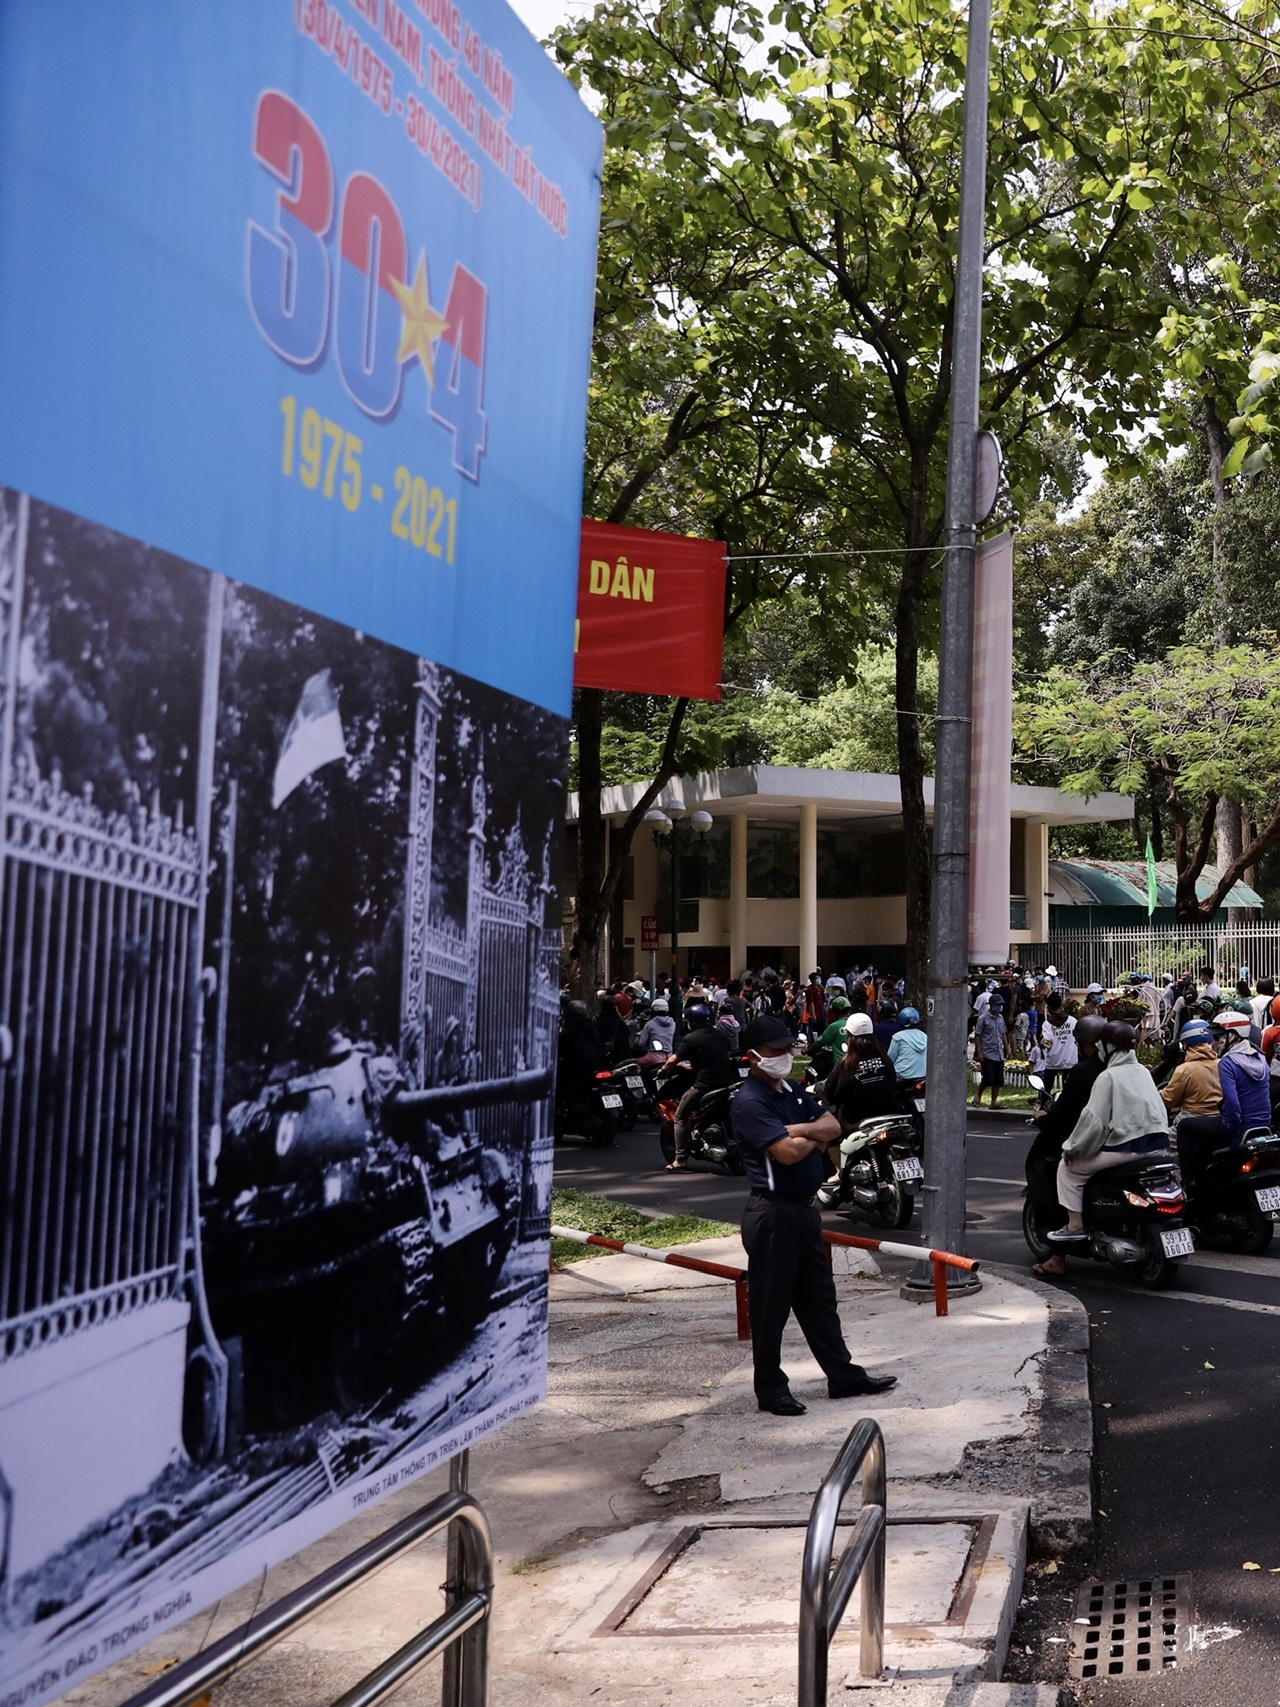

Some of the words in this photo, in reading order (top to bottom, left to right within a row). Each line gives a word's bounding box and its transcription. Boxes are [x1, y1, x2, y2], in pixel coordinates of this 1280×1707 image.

[464, 22, 481, 77] 46
[484, 46, 515, 118] NĂM
[406, 92, 482, 213] 30/4/2021)
[429, 44, 475, 137] THỐNG
[477, 102, 513, 176] NHẤT
[513, 144, 535, 203] ĐẤT
[537, 172, 568, 239] NƯỚC
[281, 395, 364, 512] 1975
[390, 465, 458, 567] 2021
[589, 556, 655, 603] DÂN
[1259, 1188, 1278, 1199] 59-S3
[1165, 1231, 1187, 1244] 59-X3
[1166, 1241, 1192, 1257] 160.16
[352, 1483, 381, 1508] TRUNG
[383, 1473, 399, 1490] TÂM
[400, 1457, 426, 1480] THÔNG
[427, 1451, 438, 1464] TIN
[475, 1418, 496, 1436] THÀNH
[101, 1615, 150, 1653] TRỌNG
[153, 1588, 193, 1625] NGHĨA
